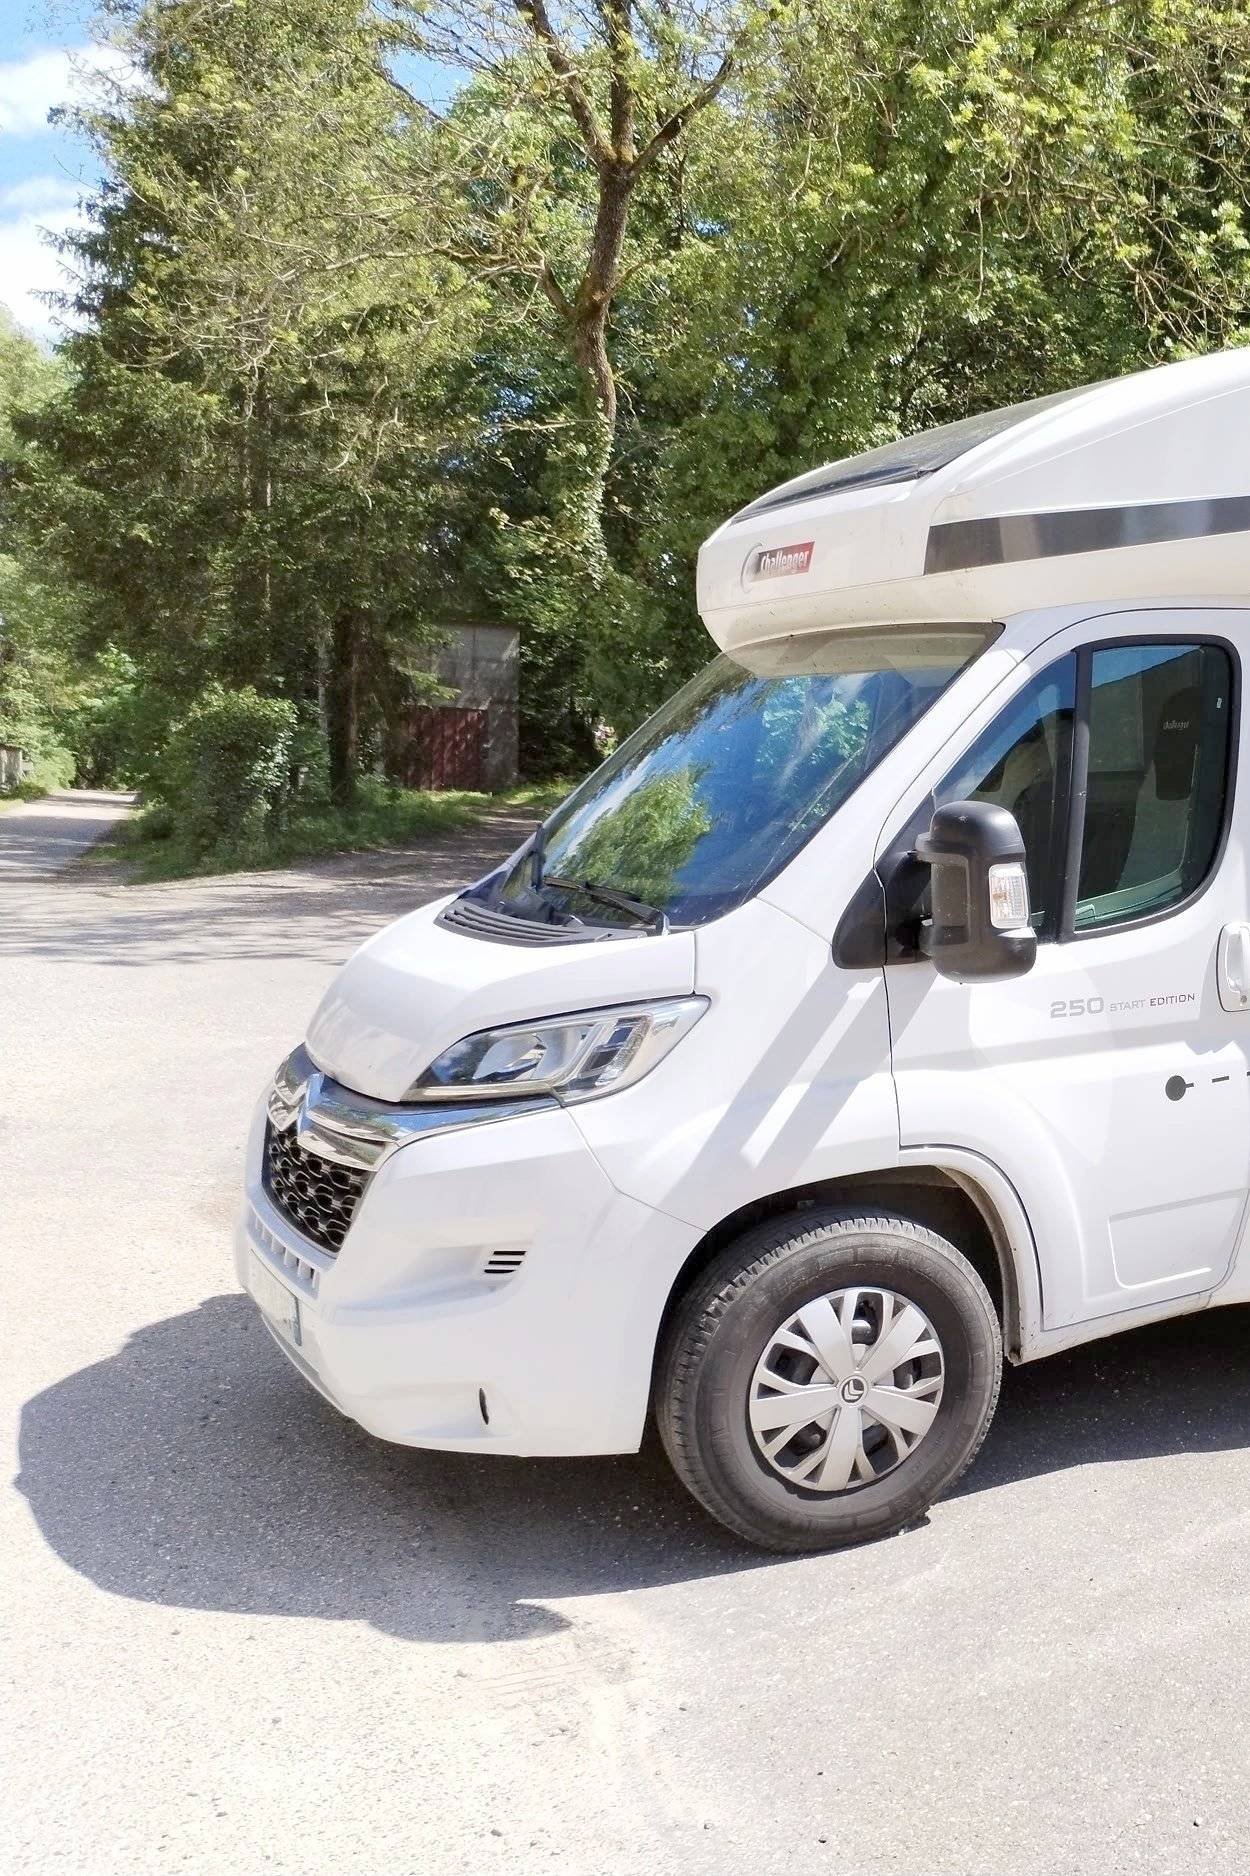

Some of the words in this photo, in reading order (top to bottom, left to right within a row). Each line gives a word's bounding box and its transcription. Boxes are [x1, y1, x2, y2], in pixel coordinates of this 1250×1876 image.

[760, 549, 810, 573] Challenger
[1050, 997, 1105, 1018] 250
[1110, 999, 1146, 1012] START
[1150, 993, 1195, 1007] EDITION
